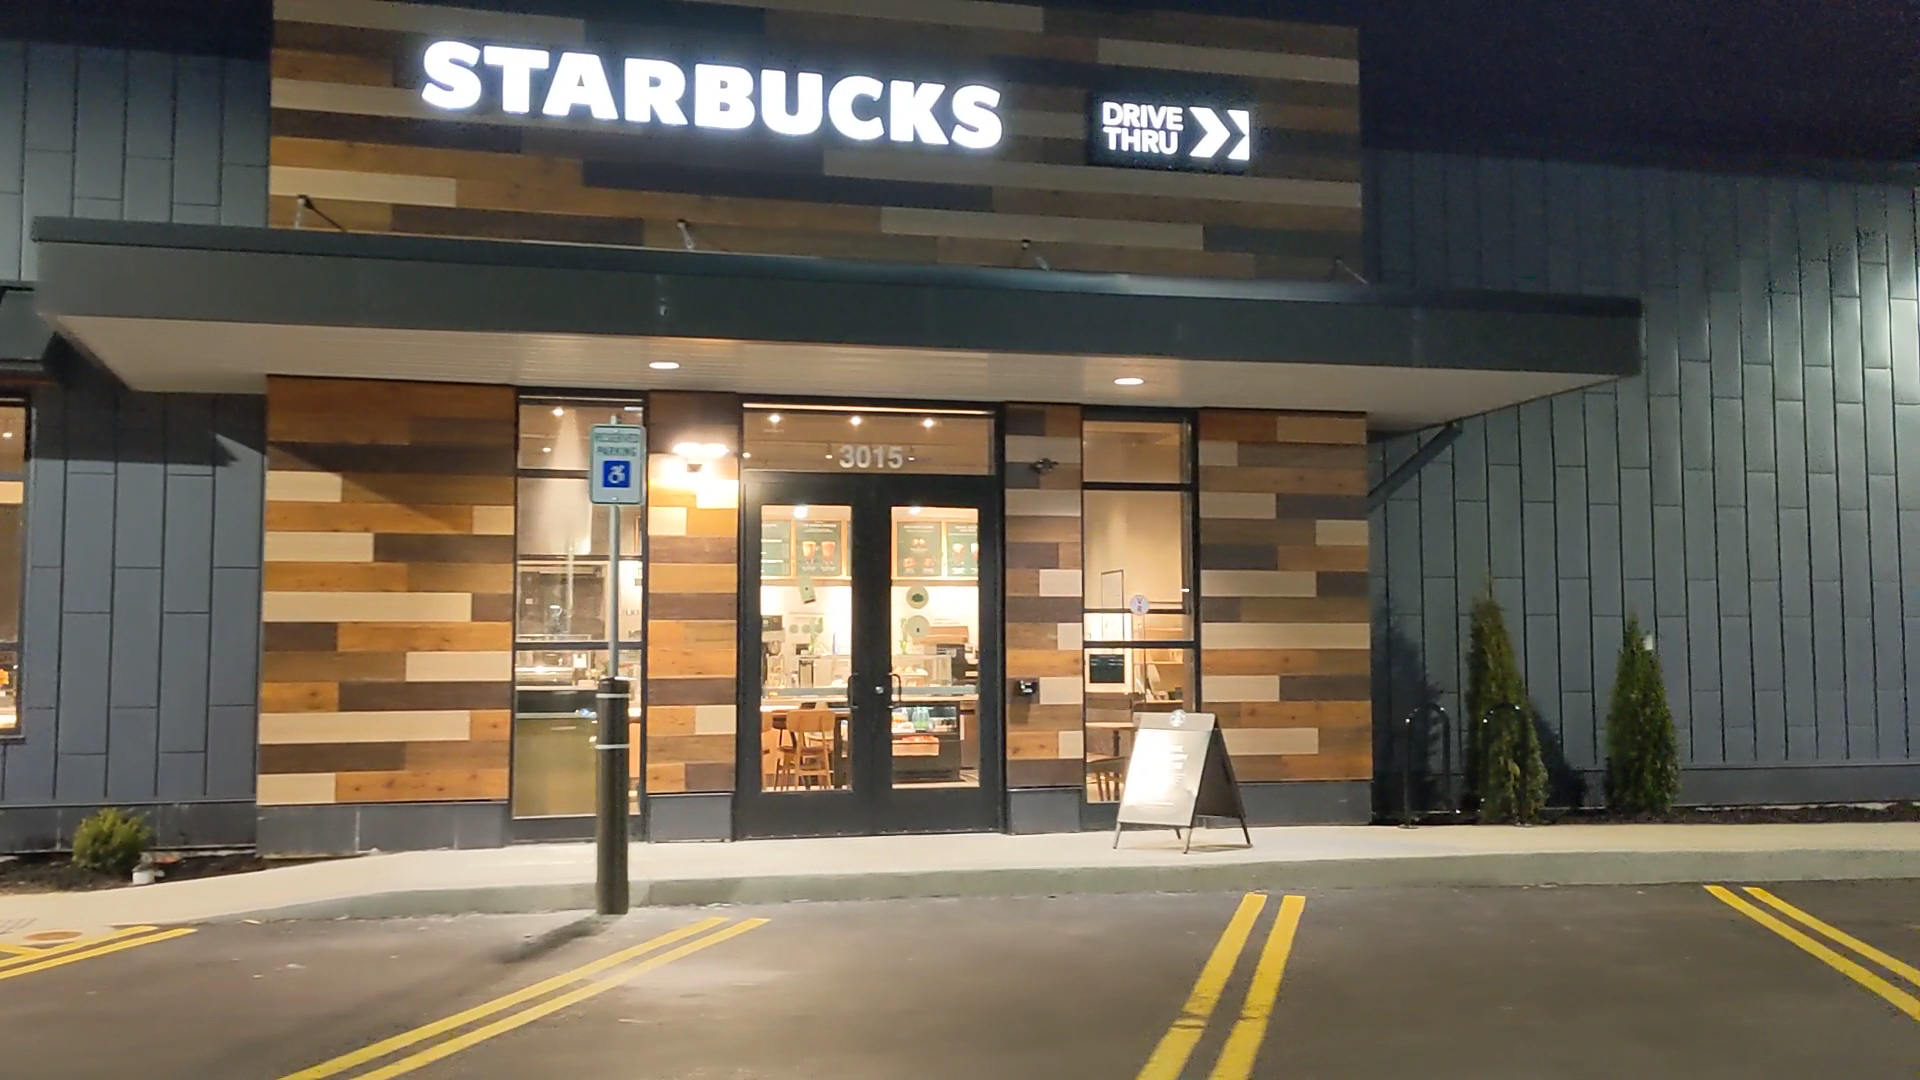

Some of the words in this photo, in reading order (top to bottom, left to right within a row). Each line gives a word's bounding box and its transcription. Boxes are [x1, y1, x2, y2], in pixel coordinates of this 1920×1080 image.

[421, 41, 1002, 149] STARBUCKS
[1102, 101, 1184, 131] DRIVE
[1102, 126, 1178, 155] THRU
[839, 444, 904, 469] 3015
